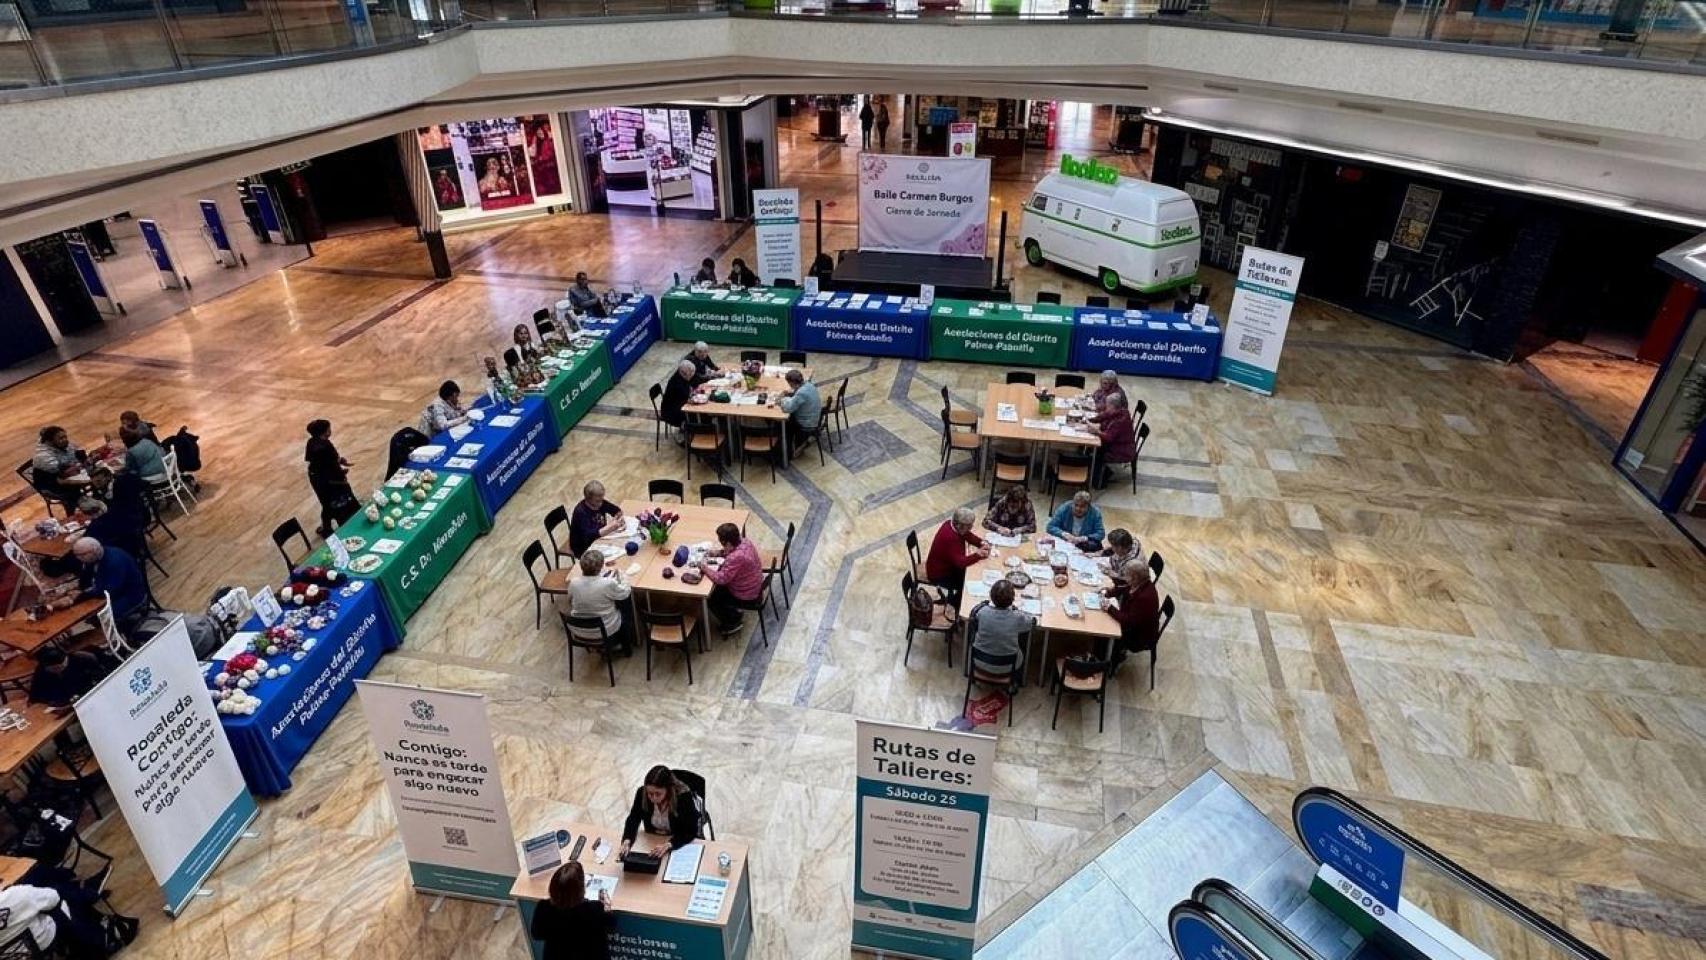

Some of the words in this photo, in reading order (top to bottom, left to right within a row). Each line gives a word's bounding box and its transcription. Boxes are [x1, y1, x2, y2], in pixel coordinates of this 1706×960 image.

[900, 190, 937, 201] Carmen
[939, 192, 974, 204] Burgos
[914, 207, 925, 217] de
[398, 739, 468, 759] Contigo:
[873, 736, 939, 761] Rutas
[945, 747, 976, 766] de
[393, 766, 425, 778] para
[431, 759, 448, 768] es
[450, 760, 488, 774] tarde
[436, 783, 480, 797] nuevo
